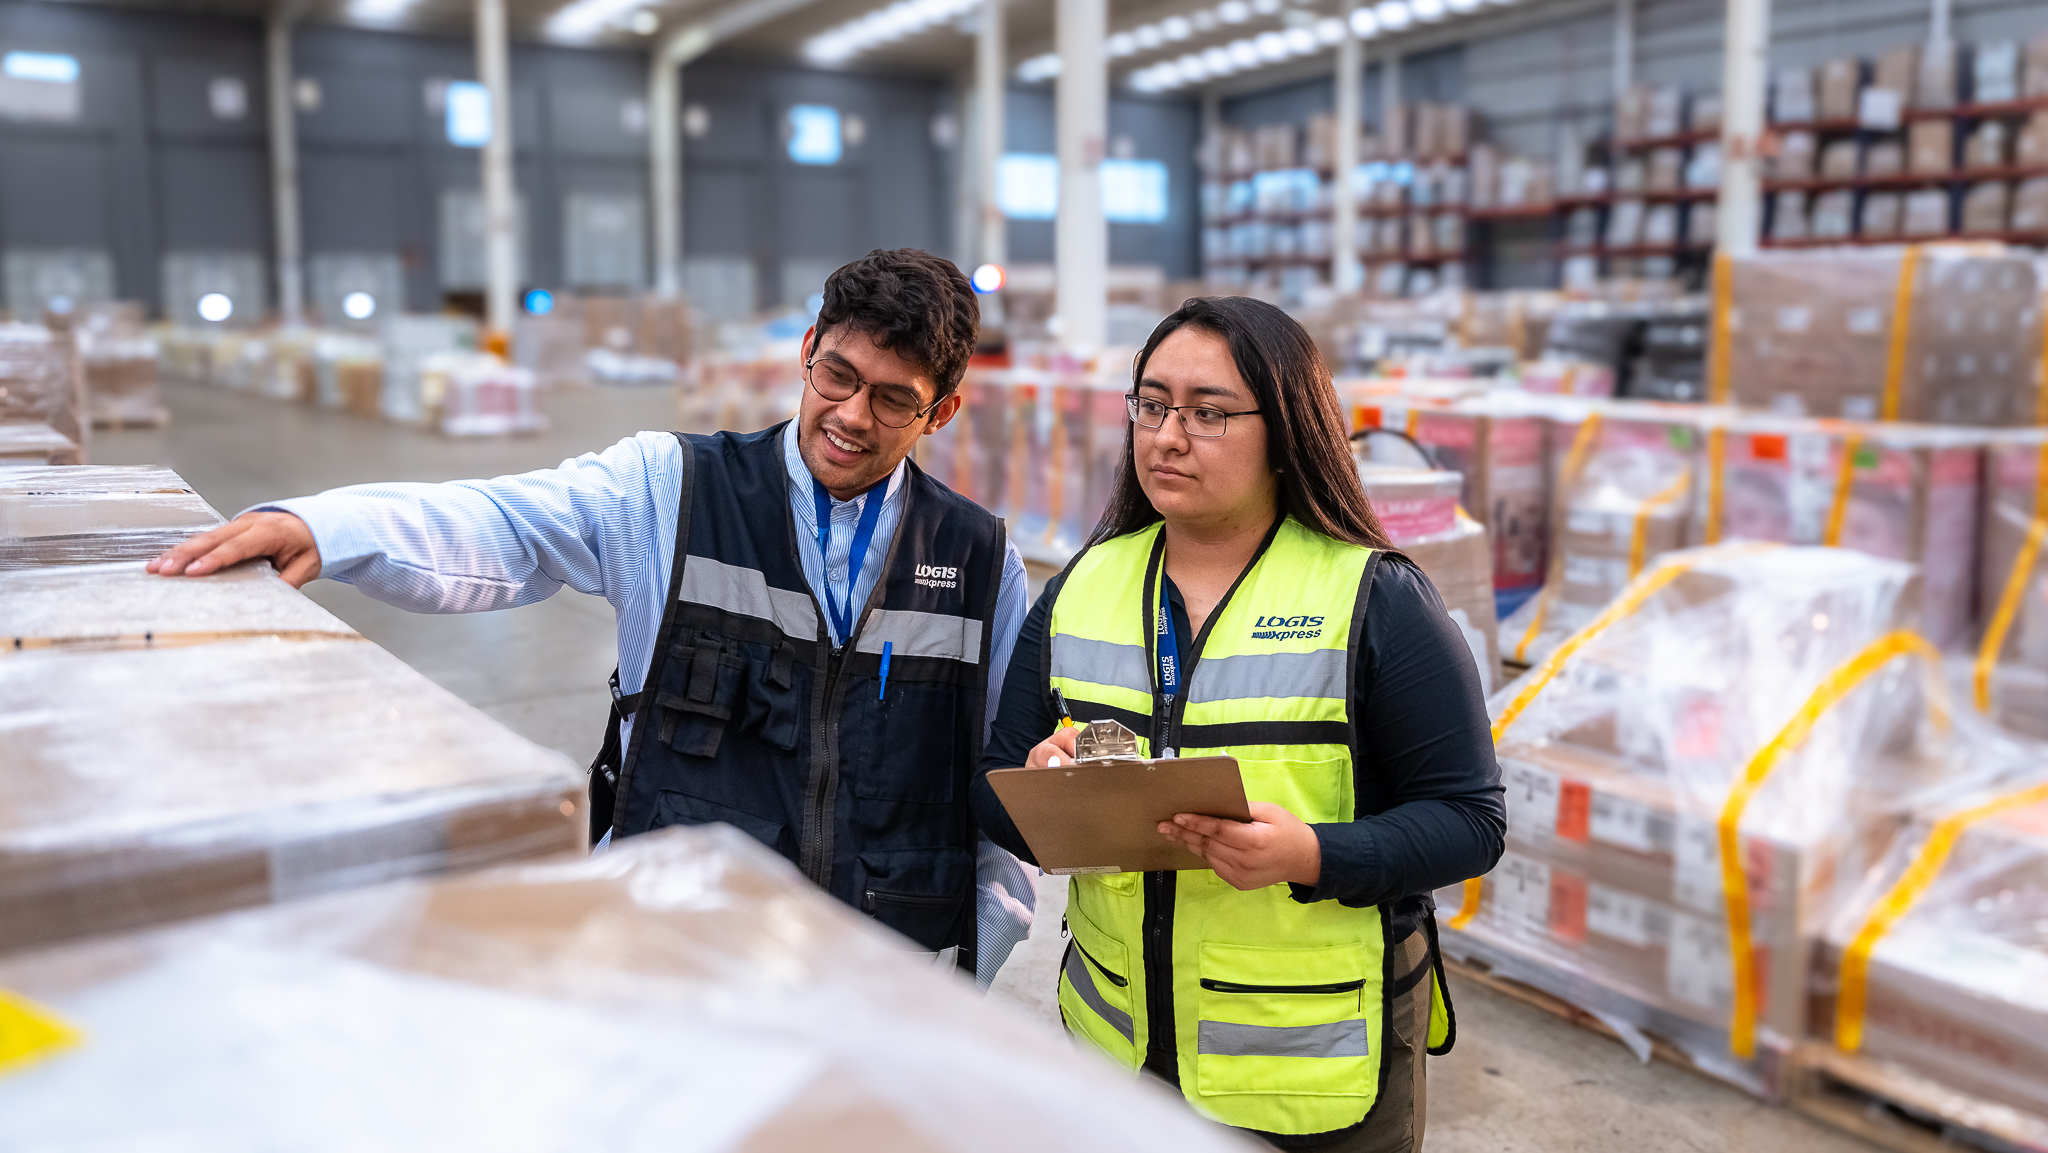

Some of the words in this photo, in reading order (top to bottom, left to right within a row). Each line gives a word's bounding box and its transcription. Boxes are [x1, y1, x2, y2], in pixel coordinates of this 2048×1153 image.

[914, 563, 958, 579] LOGIS
[1253, 615, 1325, 628] LOGIS
[1162, 656, 1173, 685] LOGIS
